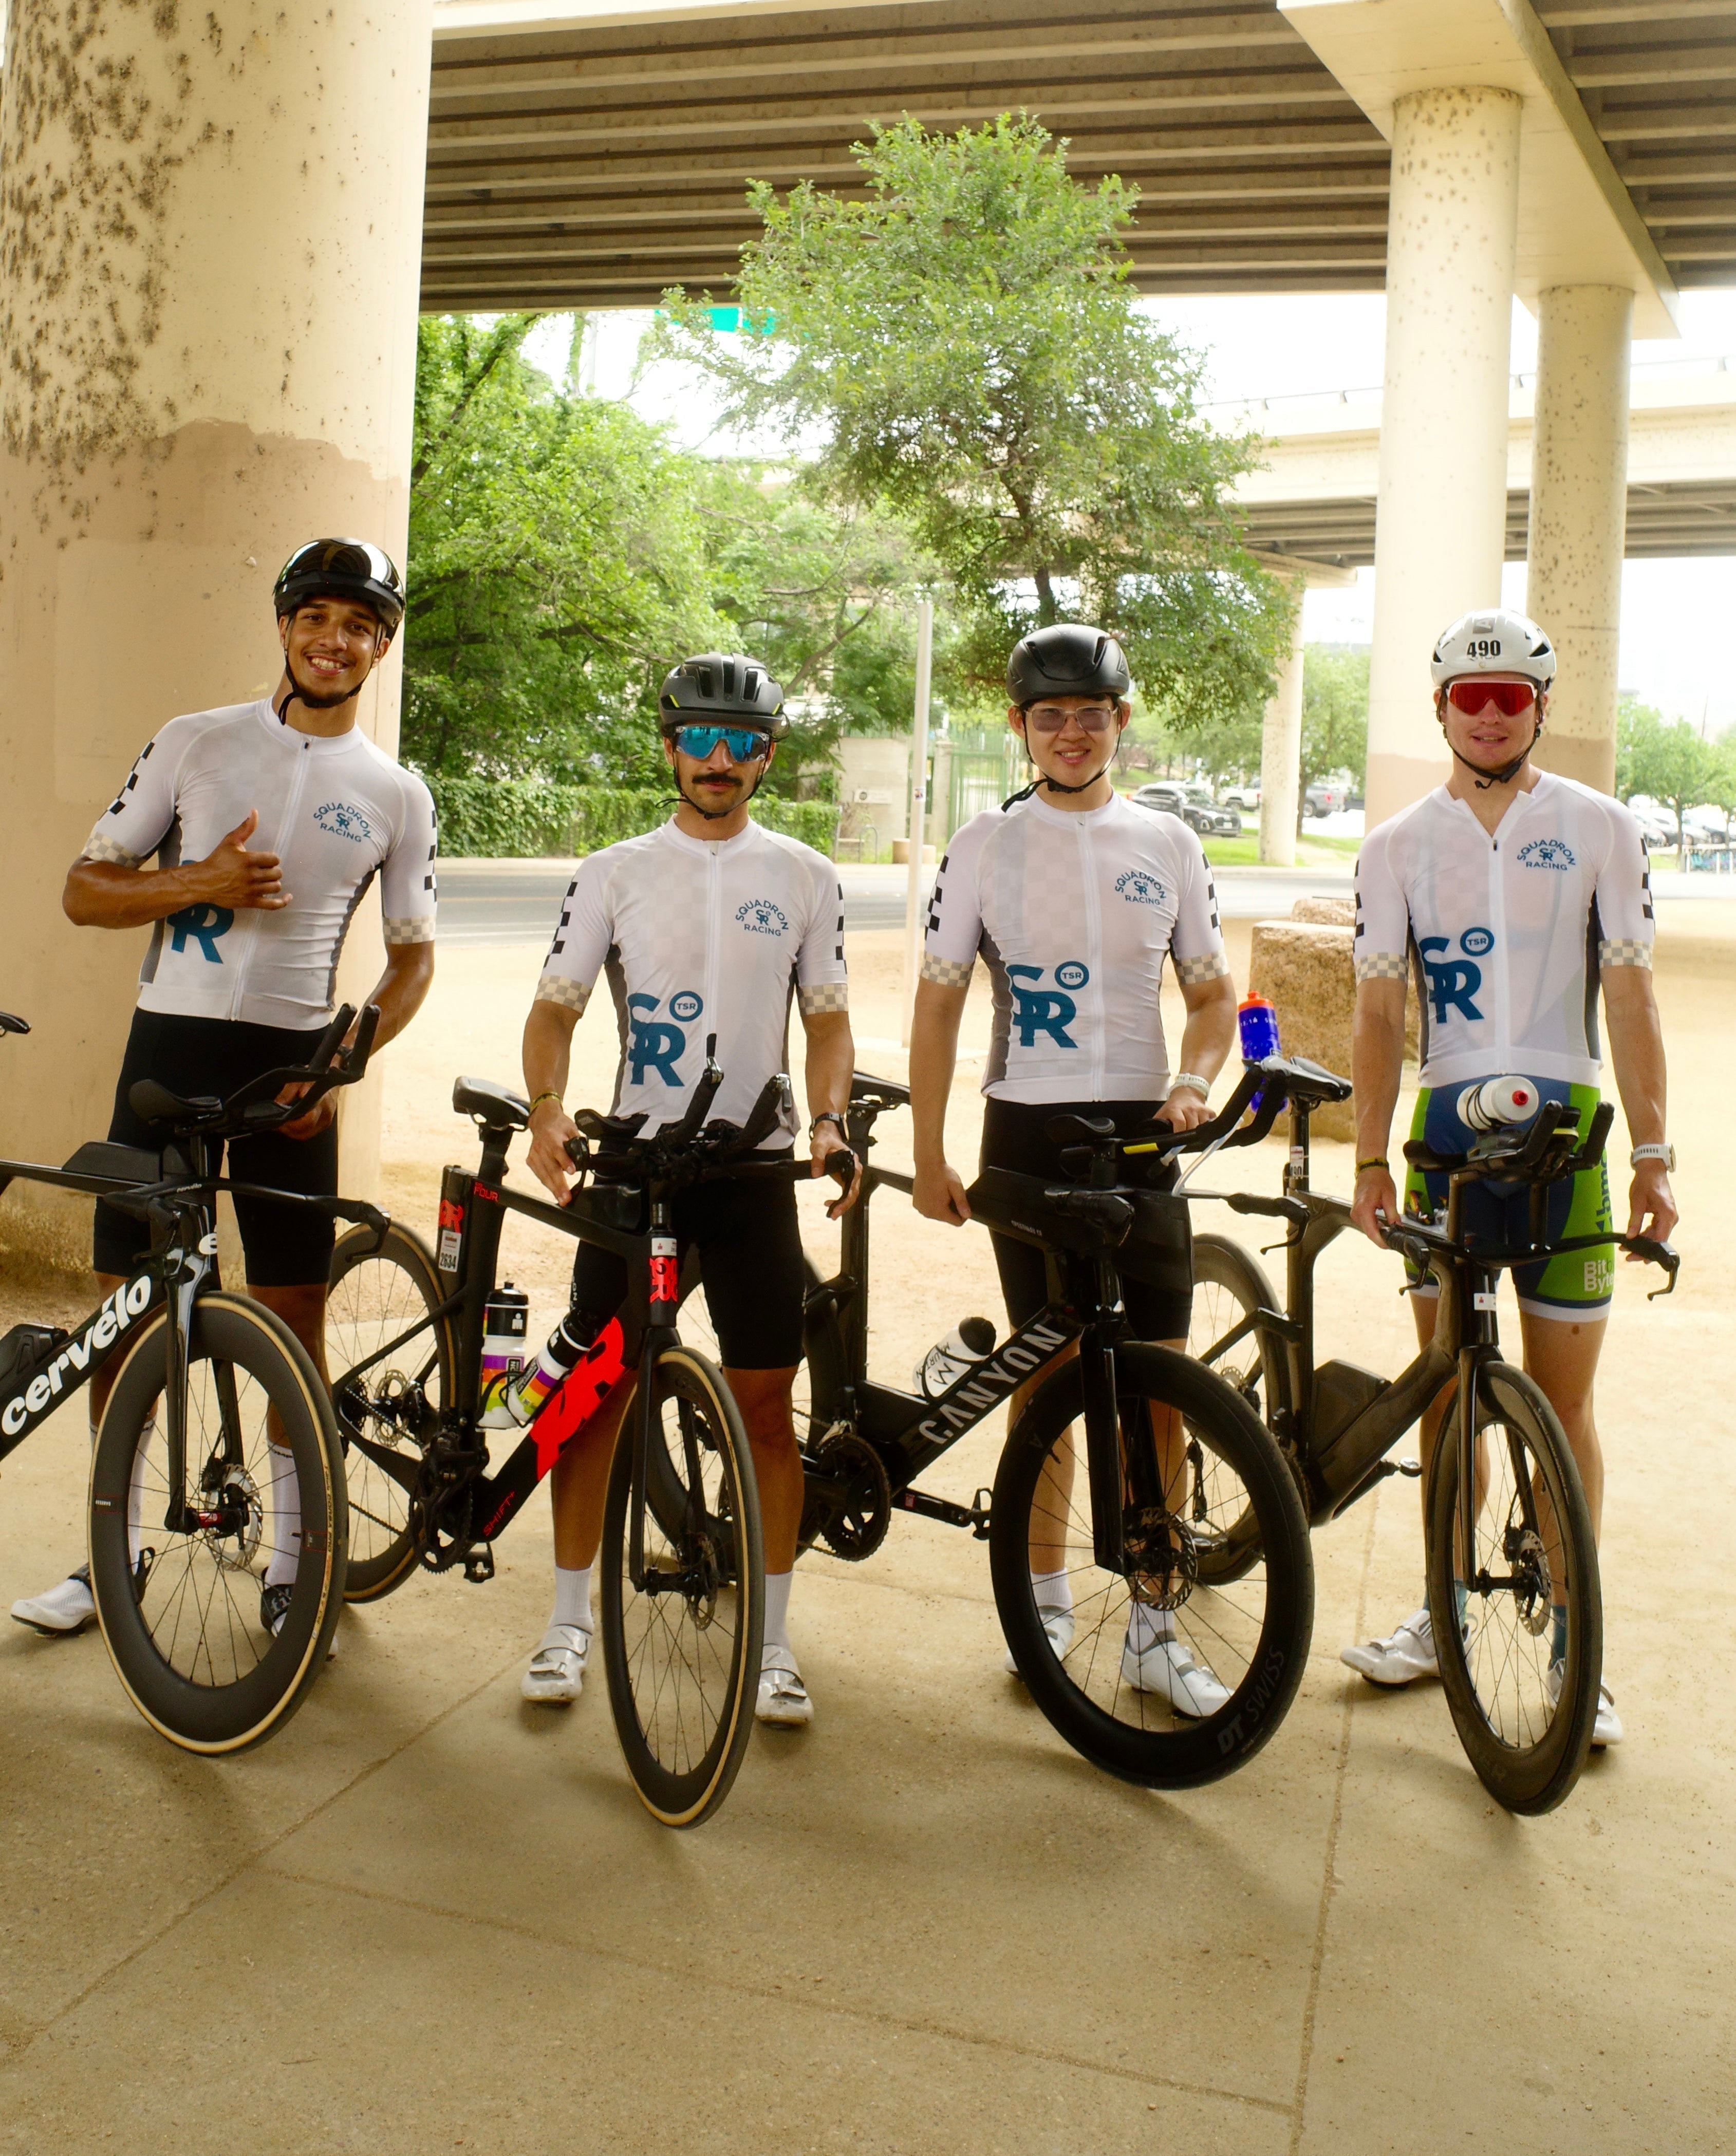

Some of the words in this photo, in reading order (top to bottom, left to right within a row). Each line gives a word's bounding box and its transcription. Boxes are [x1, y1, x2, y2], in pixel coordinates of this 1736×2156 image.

[1467, 640, 1502, 658] 490
[313, 802, 371, 839] SQUADRON
[320, 822, 362, 843] RACING
[1517, 839, 1576, 866] SQUADRON
[1525, 861, 1568, 871] RACING
[1115, 871, 1167, 899] SQUADRON
[1125, 894, 1161, 905] RACING
[735, 899, 789, 930] SQUADRON
[744, 924, 781, 936] RACING
[1466, 938, 1488, 946] TSR
[473, 1186, 498, 1203] FOUR
[2, 1275, 152, 1436] cervélo
[919, 1323, 1067, 1445] CANYON
[1217, 1713, 1245, 1755] DT
[1245, 1645, 1284, 1722] SWISS
